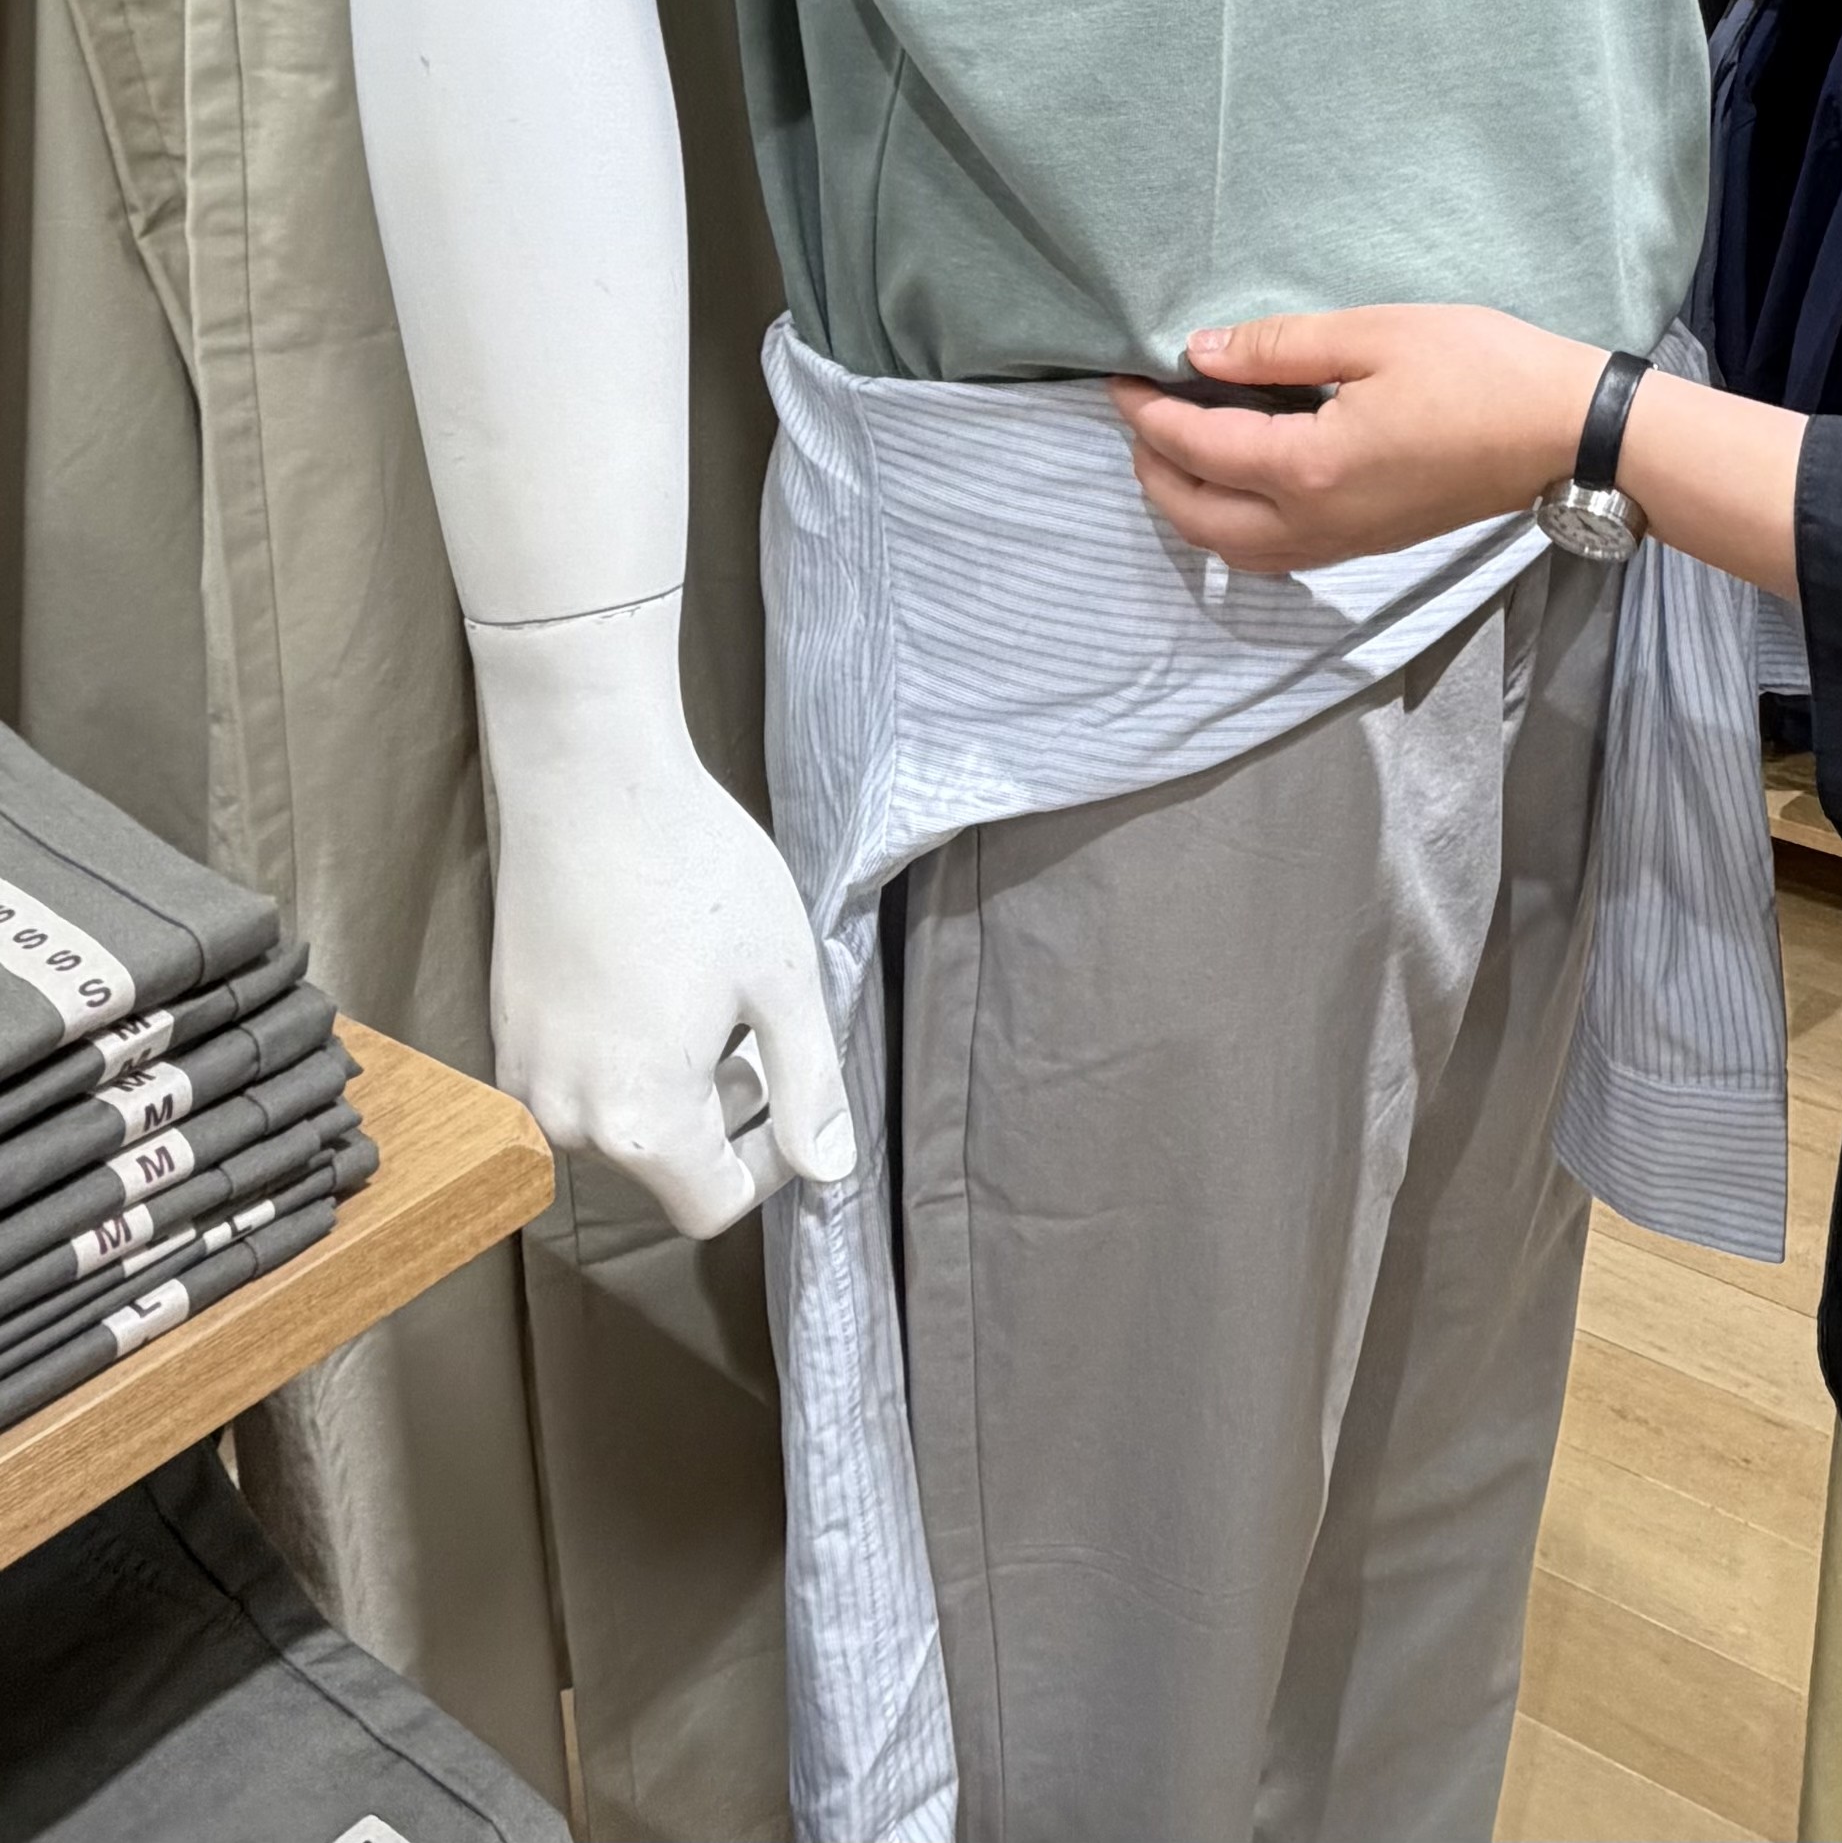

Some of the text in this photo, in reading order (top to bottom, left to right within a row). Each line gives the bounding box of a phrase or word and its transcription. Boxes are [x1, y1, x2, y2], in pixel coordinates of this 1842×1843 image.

[12, 928, 49, 950] S
[45, 949, 83, 972] S
[77, 978, 113, 1008] S
[143, 1093, 174, 1132] M
[135, 1145, 176, 1184] M
[93, 1215, 133, 1256] M
